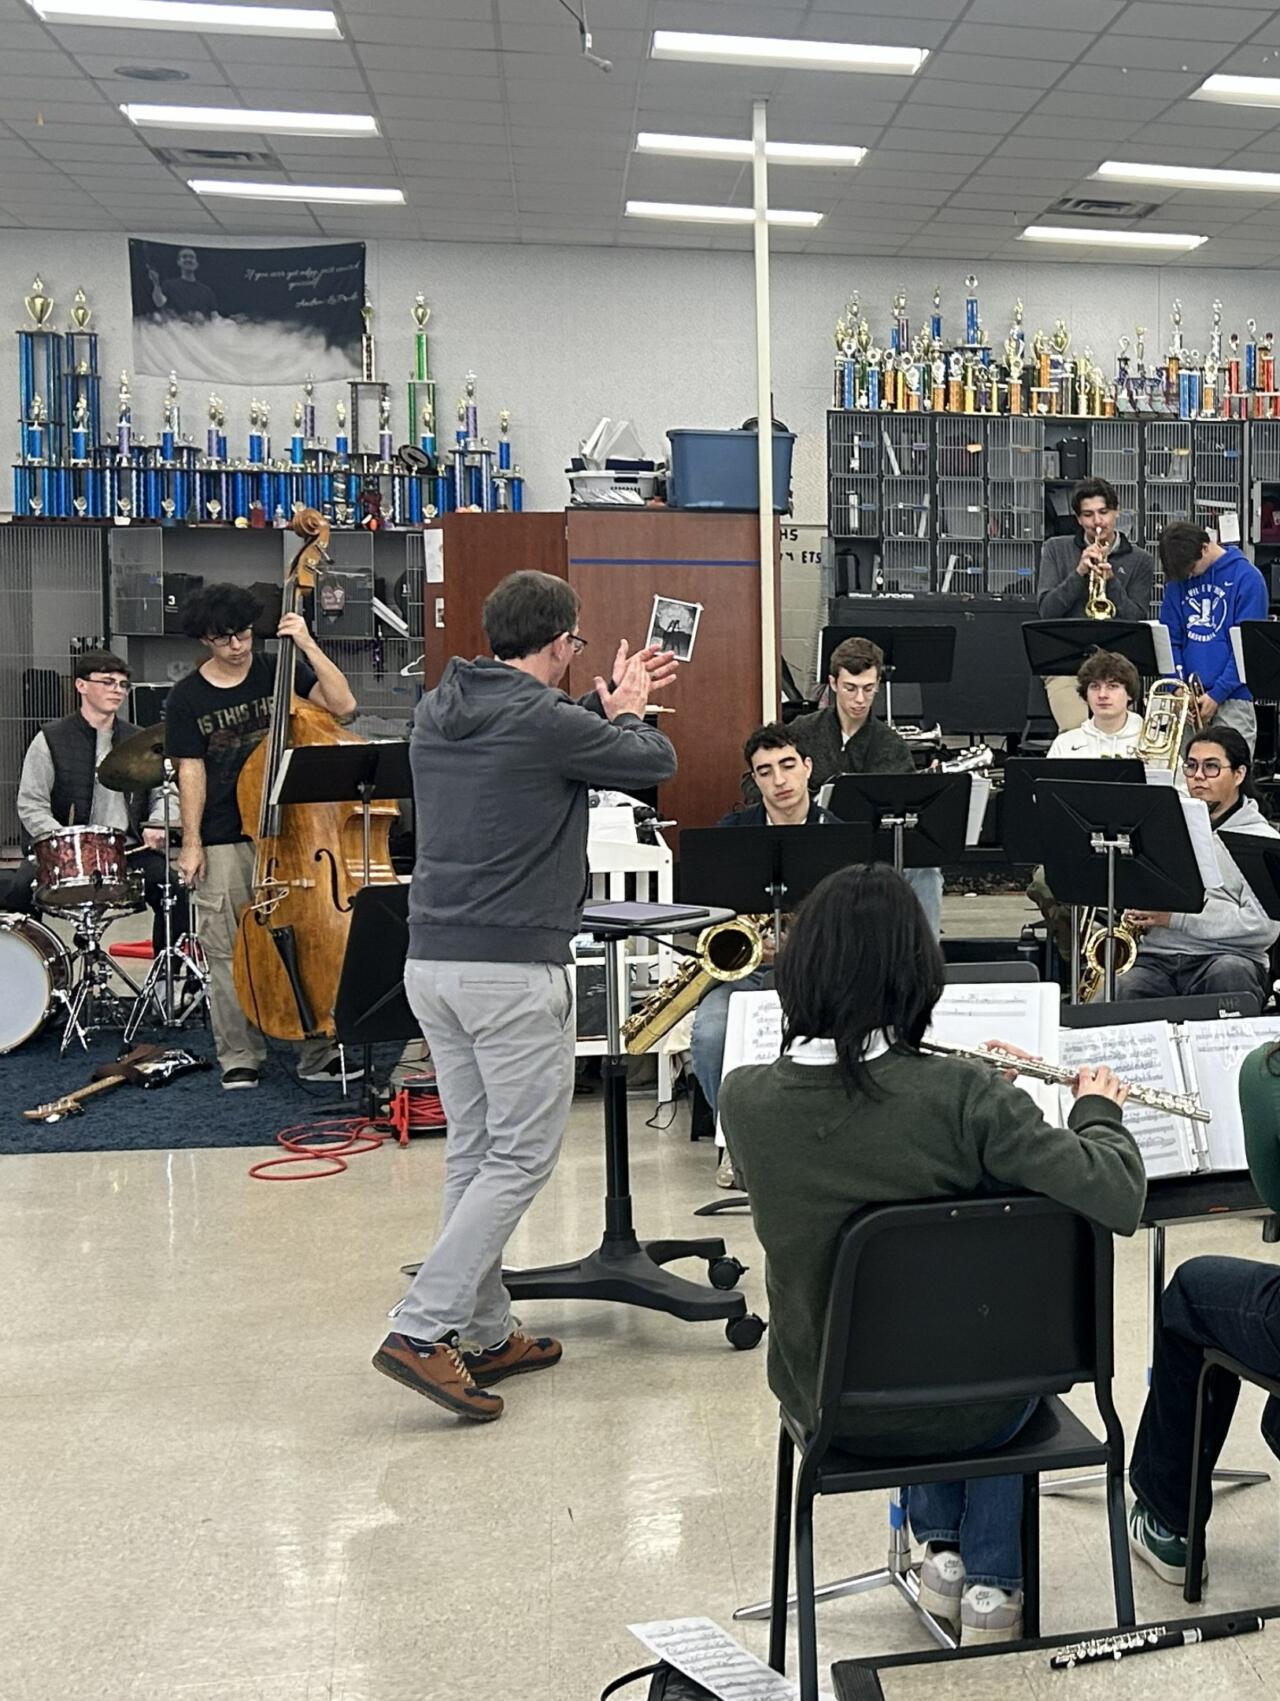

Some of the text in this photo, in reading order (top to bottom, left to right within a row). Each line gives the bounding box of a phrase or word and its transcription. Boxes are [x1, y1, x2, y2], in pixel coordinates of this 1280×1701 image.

[168, 595, 176, 605] 3
[197, 714, 213, 735] IS
[214, 703, 250, 728] THIS
